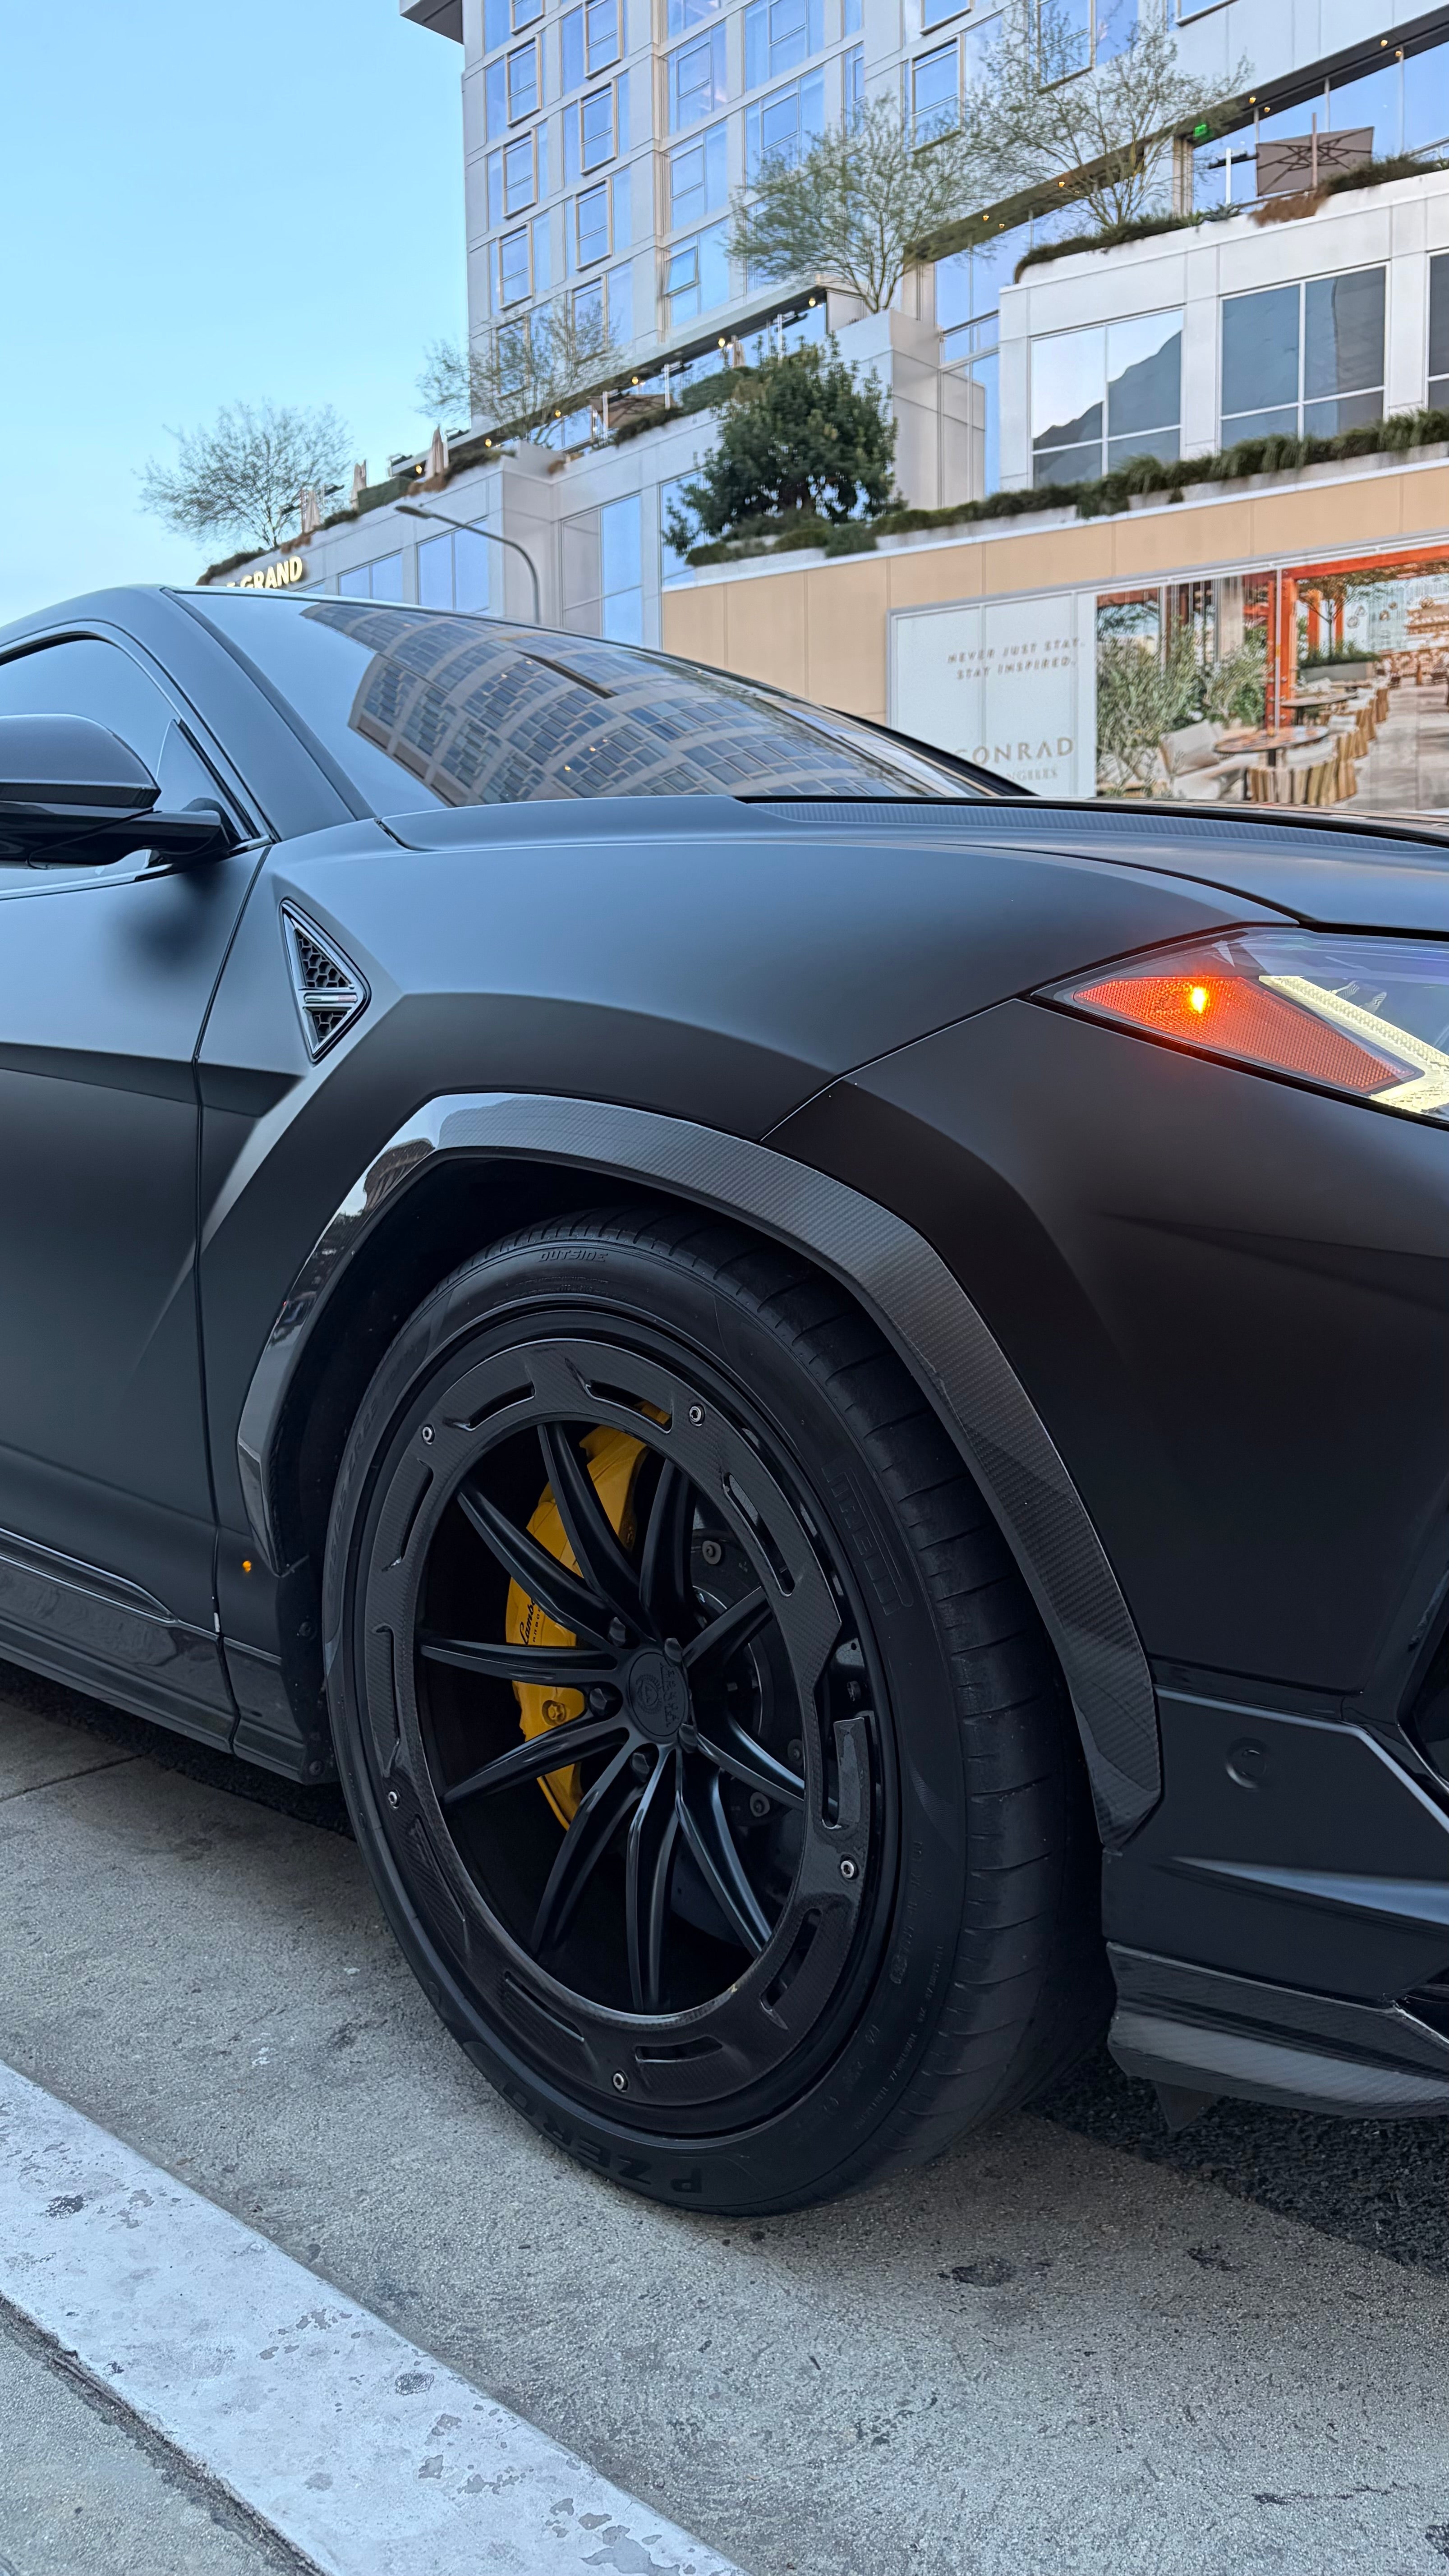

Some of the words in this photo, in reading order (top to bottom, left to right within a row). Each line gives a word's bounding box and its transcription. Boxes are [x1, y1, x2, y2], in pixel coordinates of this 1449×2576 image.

[240, 556, 303, 589] GRAND
[948, 649, 995, 663] NEVER
[1003, 643, 1037, 657] JUST
[1044, 637, 1085, 652] STAY.
[957, 667, 991, 680] STAY
[998, 656, 1076, 676] INSPIRED.
[954, 737, 1073, 765] ONRAD
[538, 1250, 608, 1262] OUTSIDE
[504, 2083, 653, 2185] ZERO
